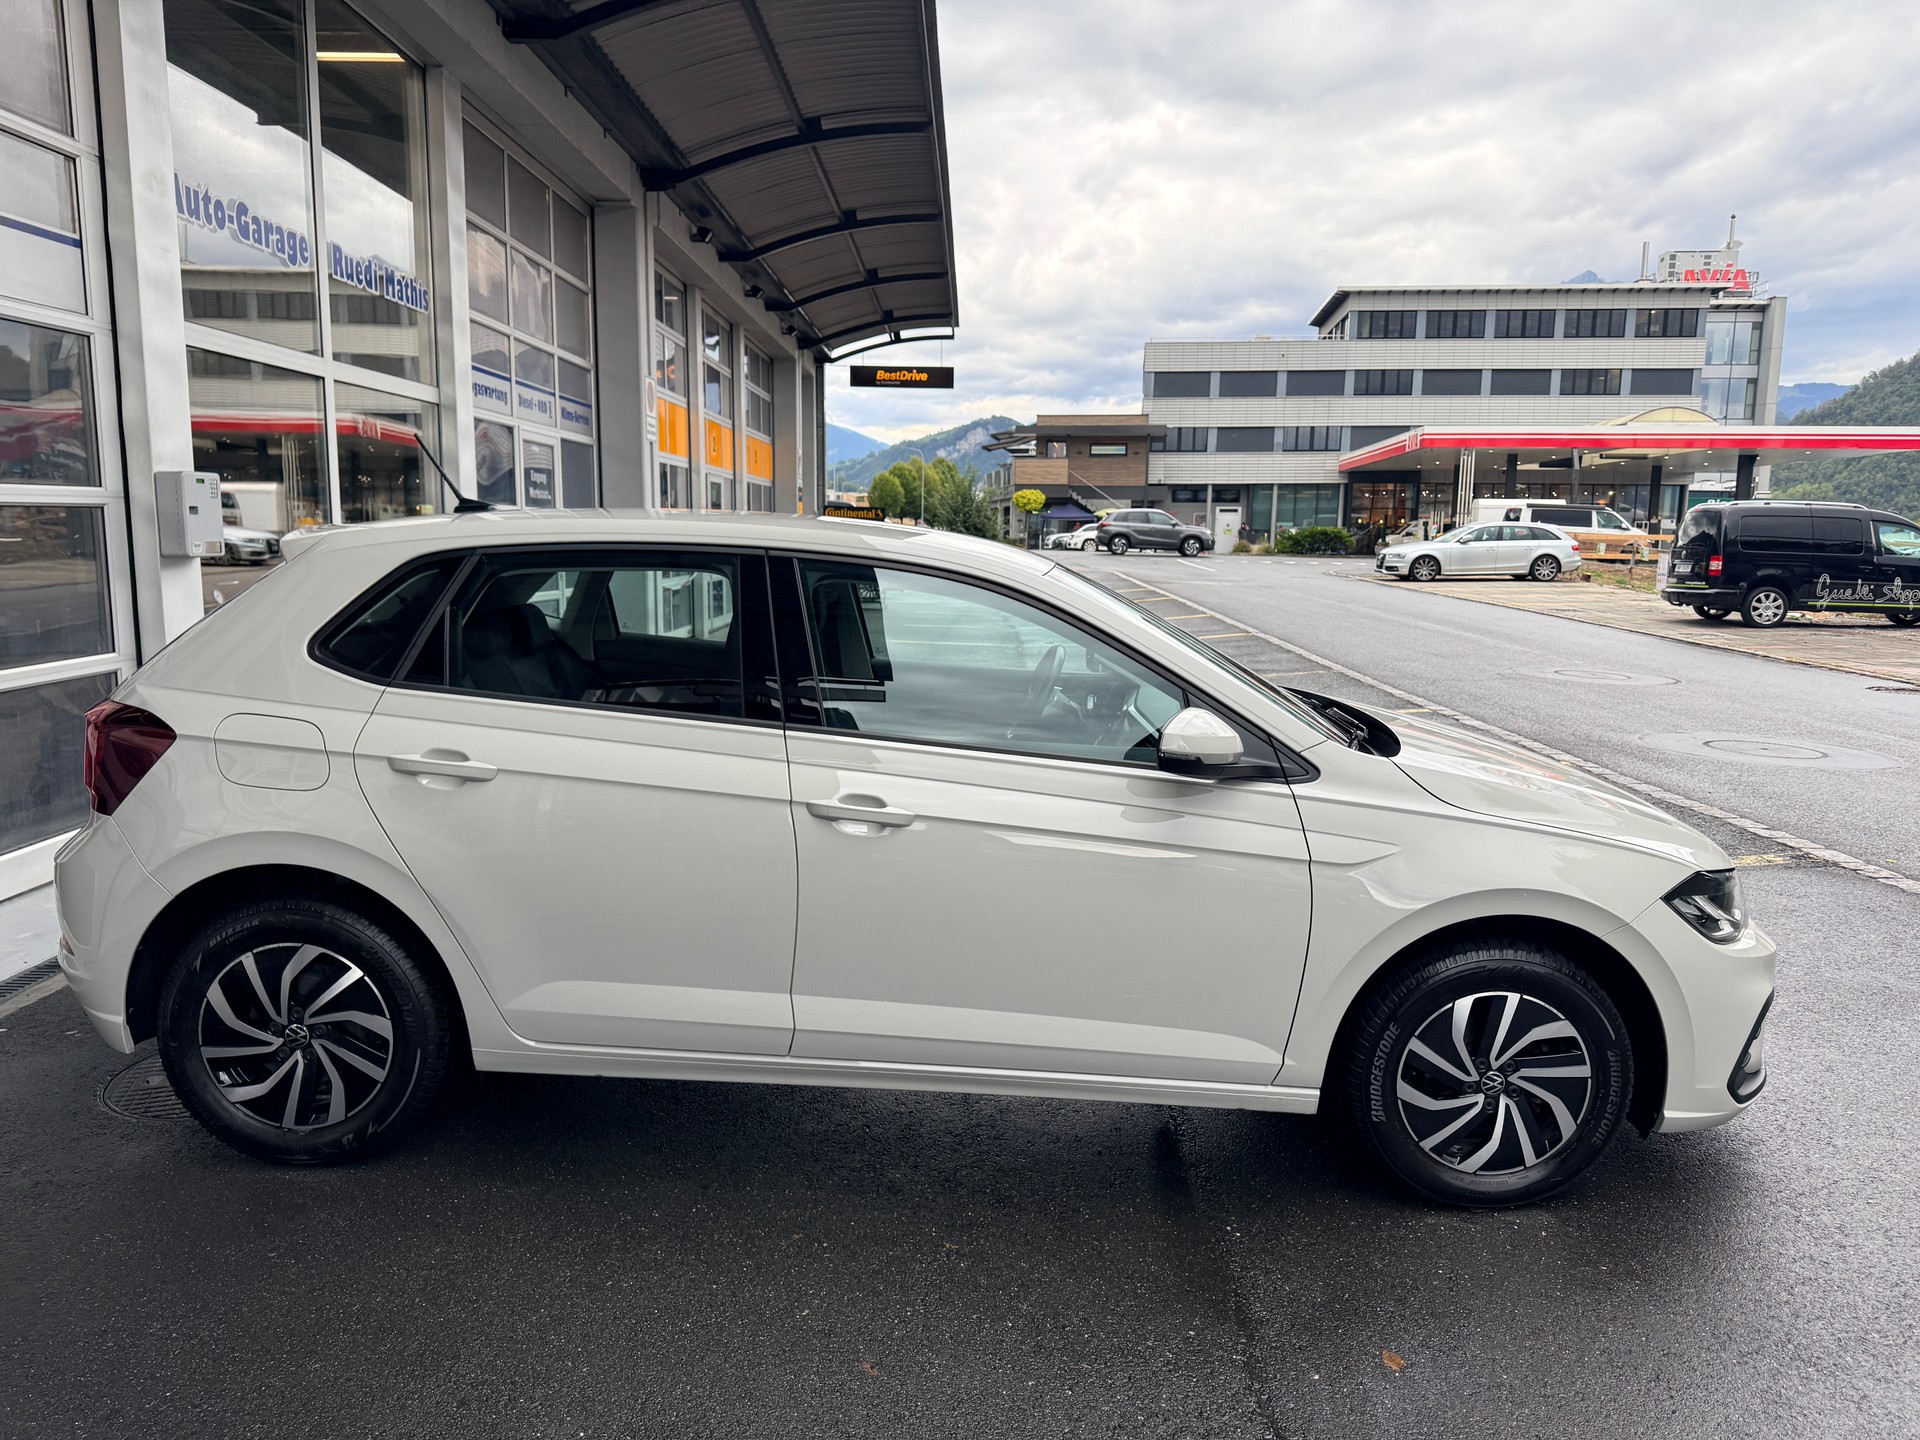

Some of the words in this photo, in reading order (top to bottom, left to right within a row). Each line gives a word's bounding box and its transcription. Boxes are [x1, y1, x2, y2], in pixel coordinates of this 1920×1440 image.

[173, 172, 310, 267] Auto-Garage
[332, 243, 380, 294] Ruedi
[384, 265, 429, 313] Mathis
[876, 369, 928, 382] BestDrive
[825, 507, 875, 518] Continental
[1370, 1021, 1401, 1123] BRIDGESTONE
[1590, 1048, 1623, 1149] BRIDGESTONE
